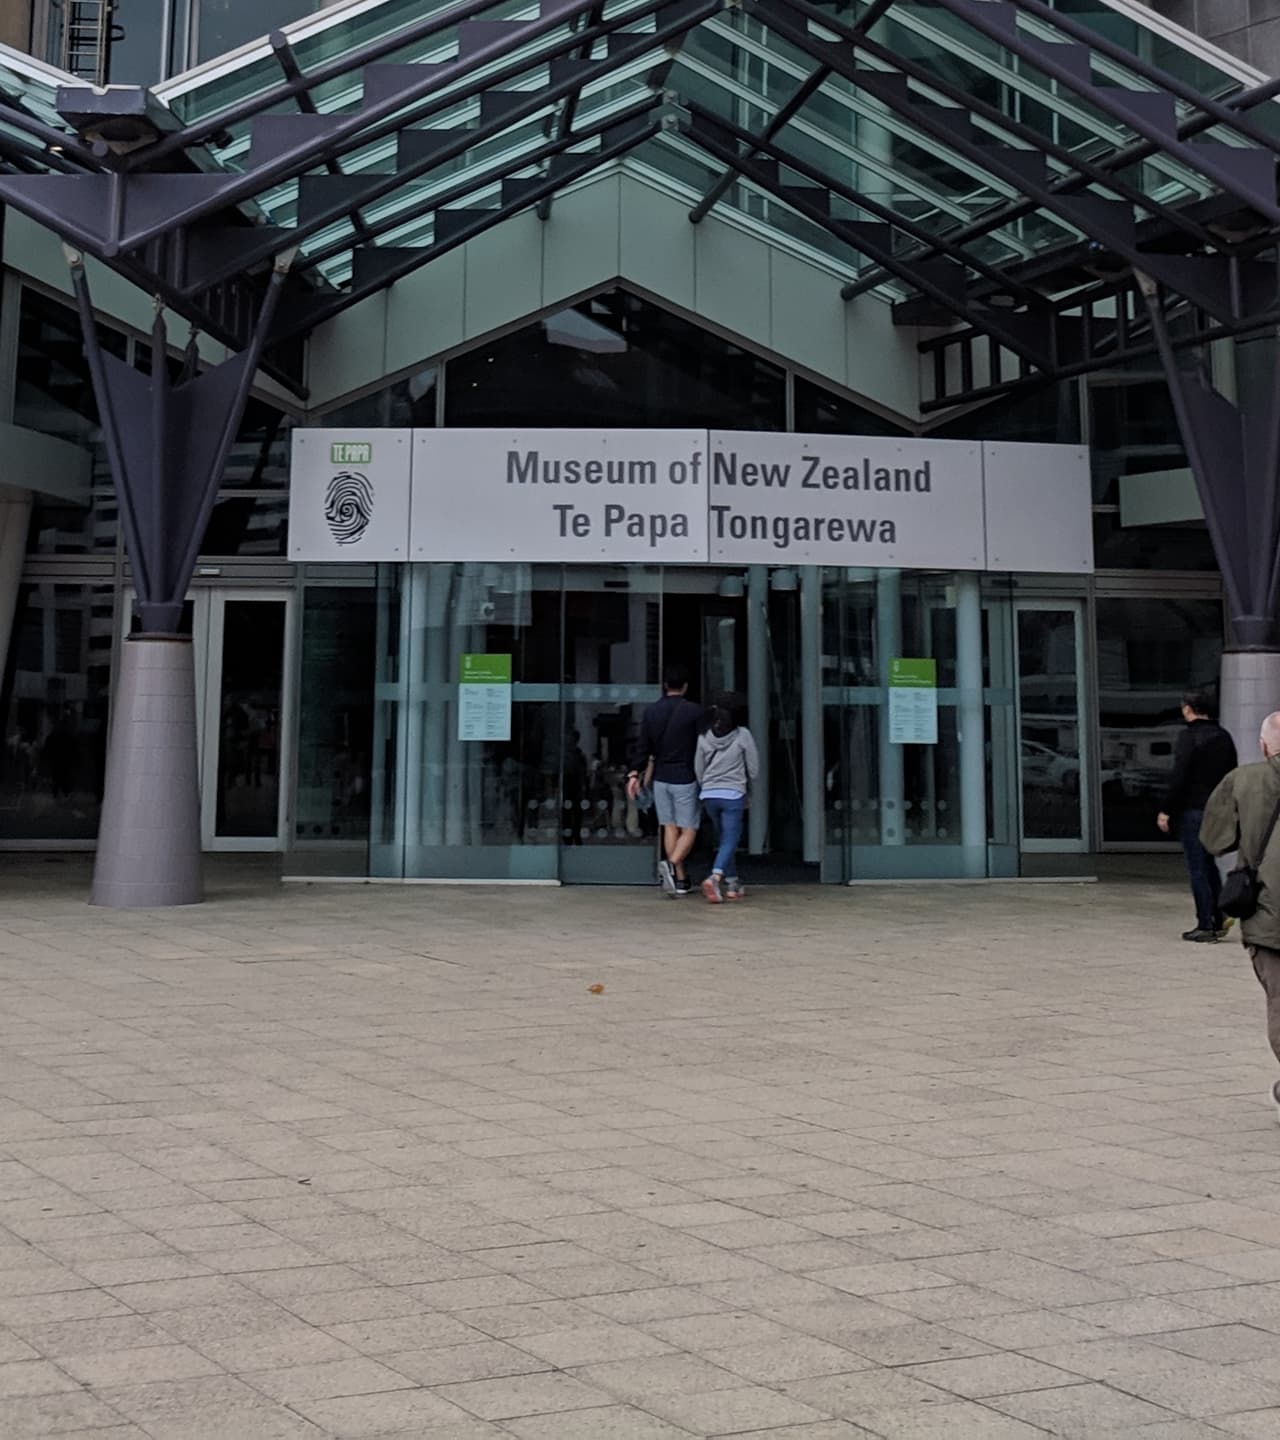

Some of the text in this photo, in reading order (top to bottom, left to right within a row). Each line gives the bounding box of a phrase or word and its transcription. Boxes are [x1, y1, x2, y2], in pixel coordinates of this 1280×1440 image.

[332, 444, 369, 461] TE PAPA
[506, 451, 932, 492] Museum of New Zealand
[553, 504, 897, 549] Te Papa Tongarewa
